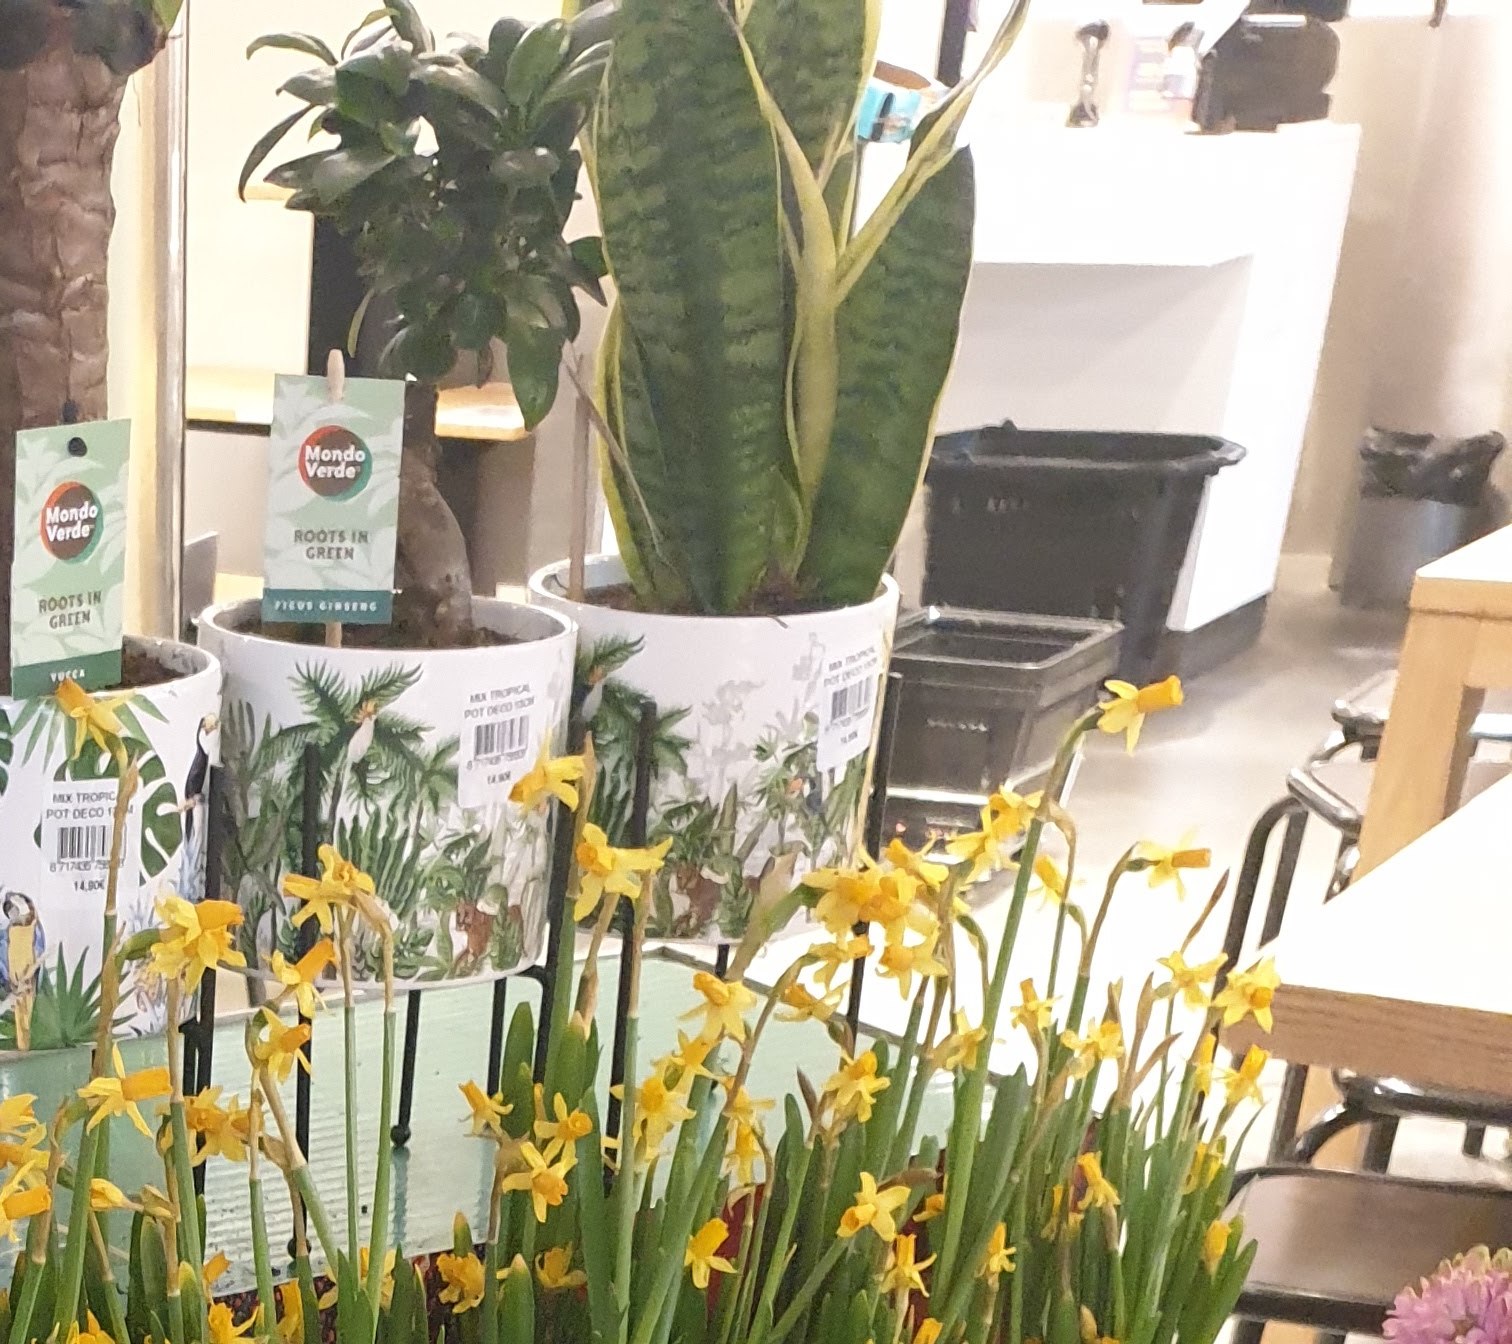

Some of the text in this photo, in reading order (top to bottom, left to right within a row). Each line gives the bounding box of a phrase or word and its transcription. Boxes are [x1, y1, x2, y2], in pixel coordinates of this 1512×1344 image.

[304, 444, 366, 463] Mondo
[305, 461, 356, 479] Verde
[45, 504, 99, 525] Mondo
[45, 523, 91, 542] Verde
[294, 529, 369, 544] ROOTS IN
[305, 546, 355, 560] GREEN
[38, 590, 102, 613] ROOTS IN
[274, 600, 314, 611] FICUS
[49, 610, 91, 629] GREEN
[52, 791, 117, 804] MIX TROPIC
[46, 808, 69, 820] POT
[72, 807, 105, 820] DECO
